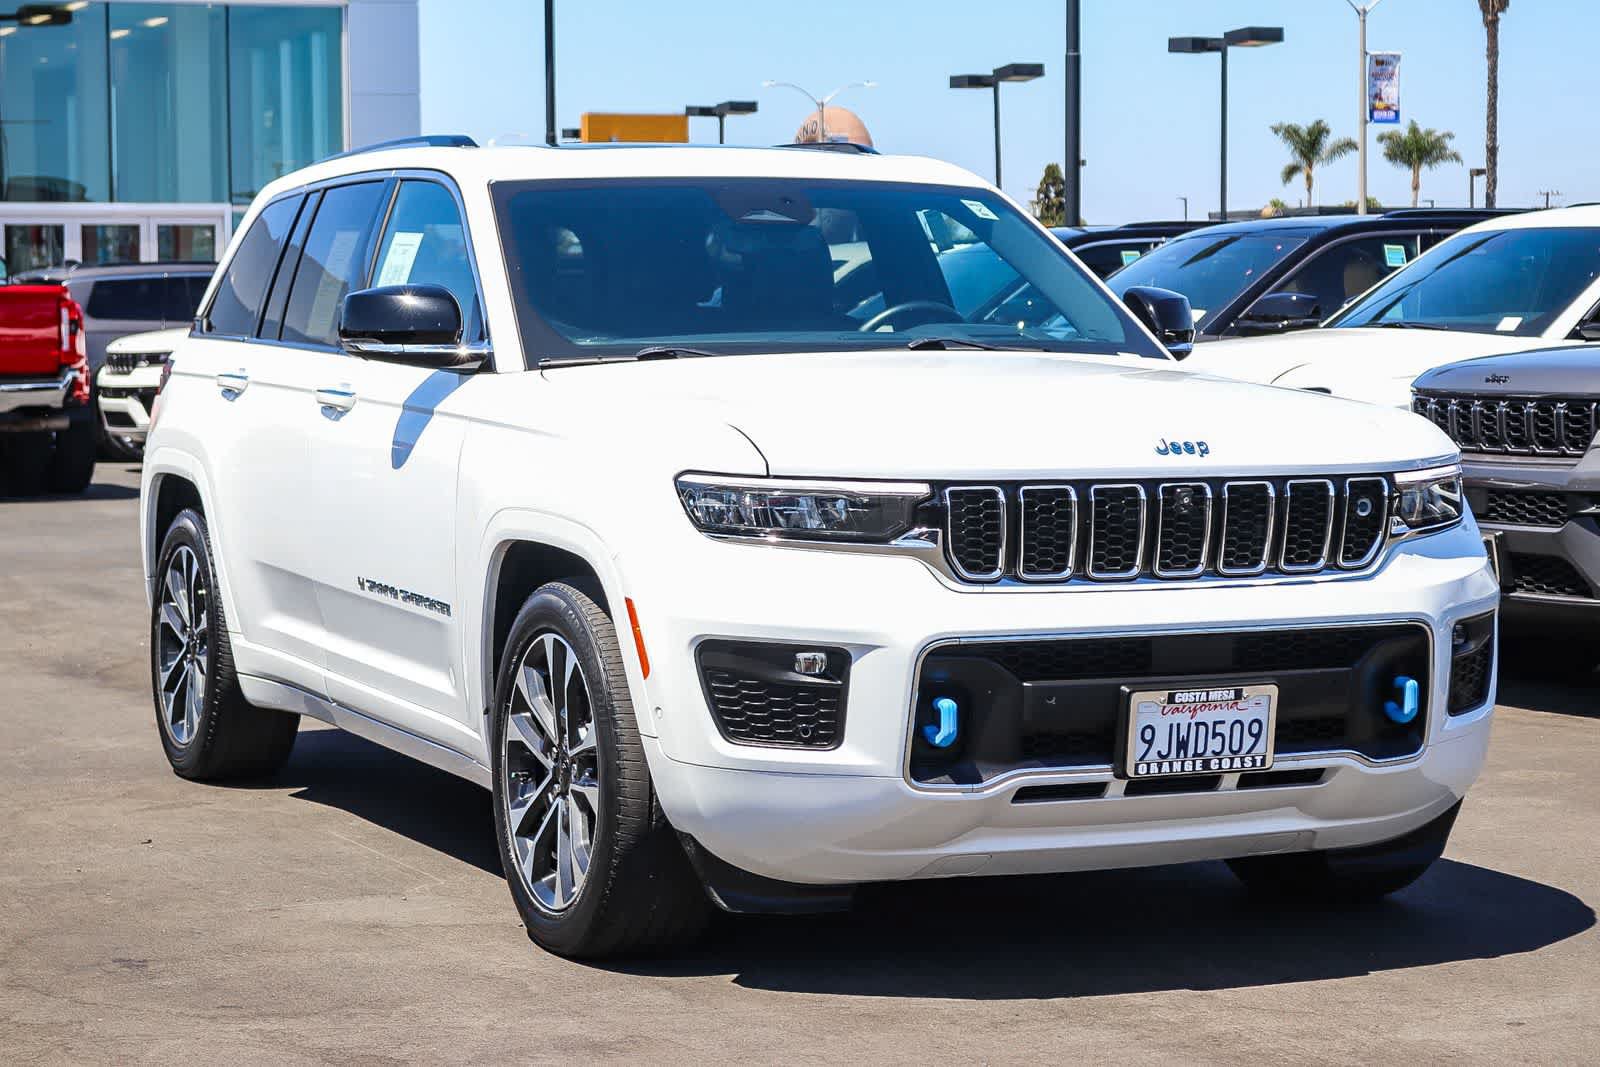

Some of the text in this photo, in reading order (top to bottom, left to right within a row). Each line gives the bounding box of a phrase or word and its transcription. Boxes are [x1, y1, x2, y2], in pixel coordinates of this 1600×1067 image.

[1155, 438, 1210, 458] Jeep
[1175, 688, 1235, 703] COSTA MESA
[1160, 701, 1248, 720] California
[1139, 718, 1264, 761] 9JWD509
[1138, 755, 1264, 775] ORANGE COAST
